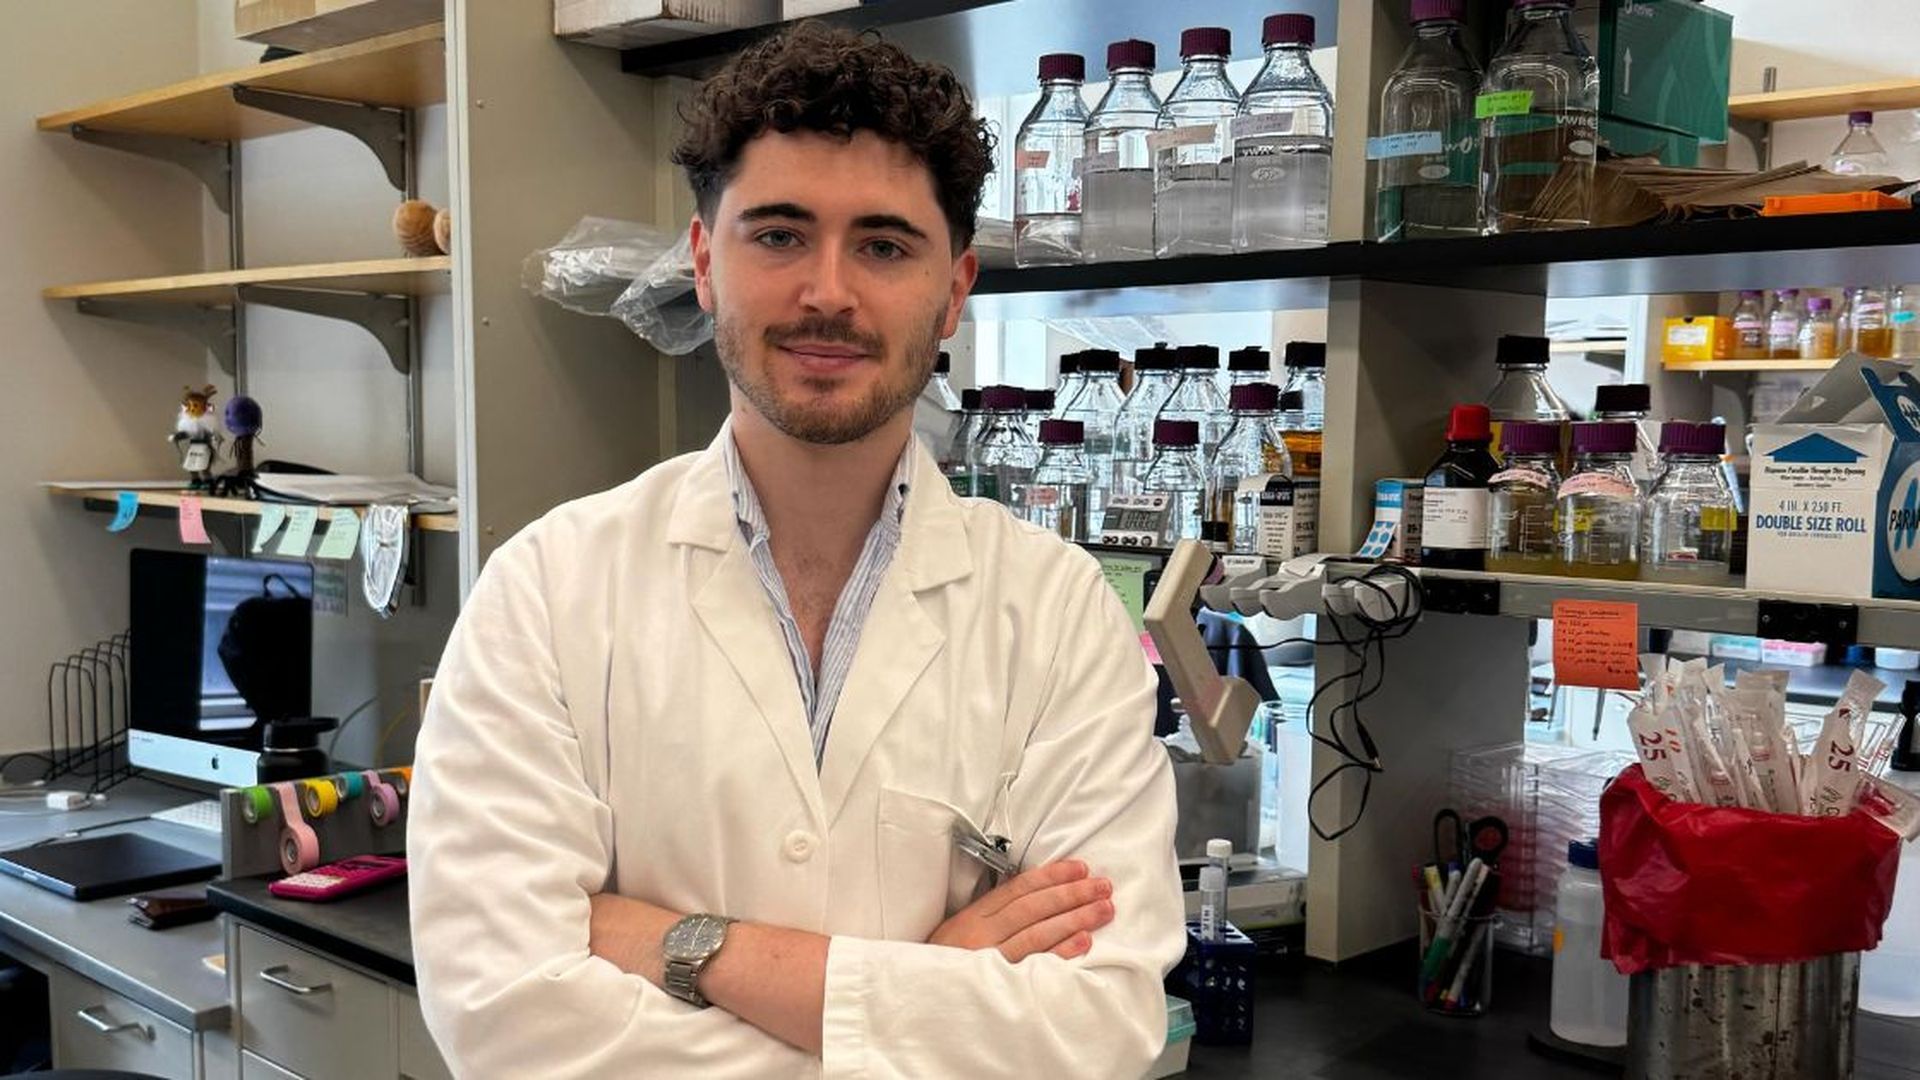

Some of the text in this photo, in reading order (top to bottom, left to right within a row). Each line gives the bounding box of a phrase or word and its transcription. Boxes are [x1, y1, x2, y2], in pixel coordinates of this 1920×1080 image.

[1779, 500, 1785, 512] 4
[1803, 501, 1809, 512] X
[1811, 501, 1829, 513] 250
[1756, 514, 1867, 533] DOUBLE SIZE ROLL
[1639, 731, 1667, 761] 25
[1828, 740, 1855, 773] 25
